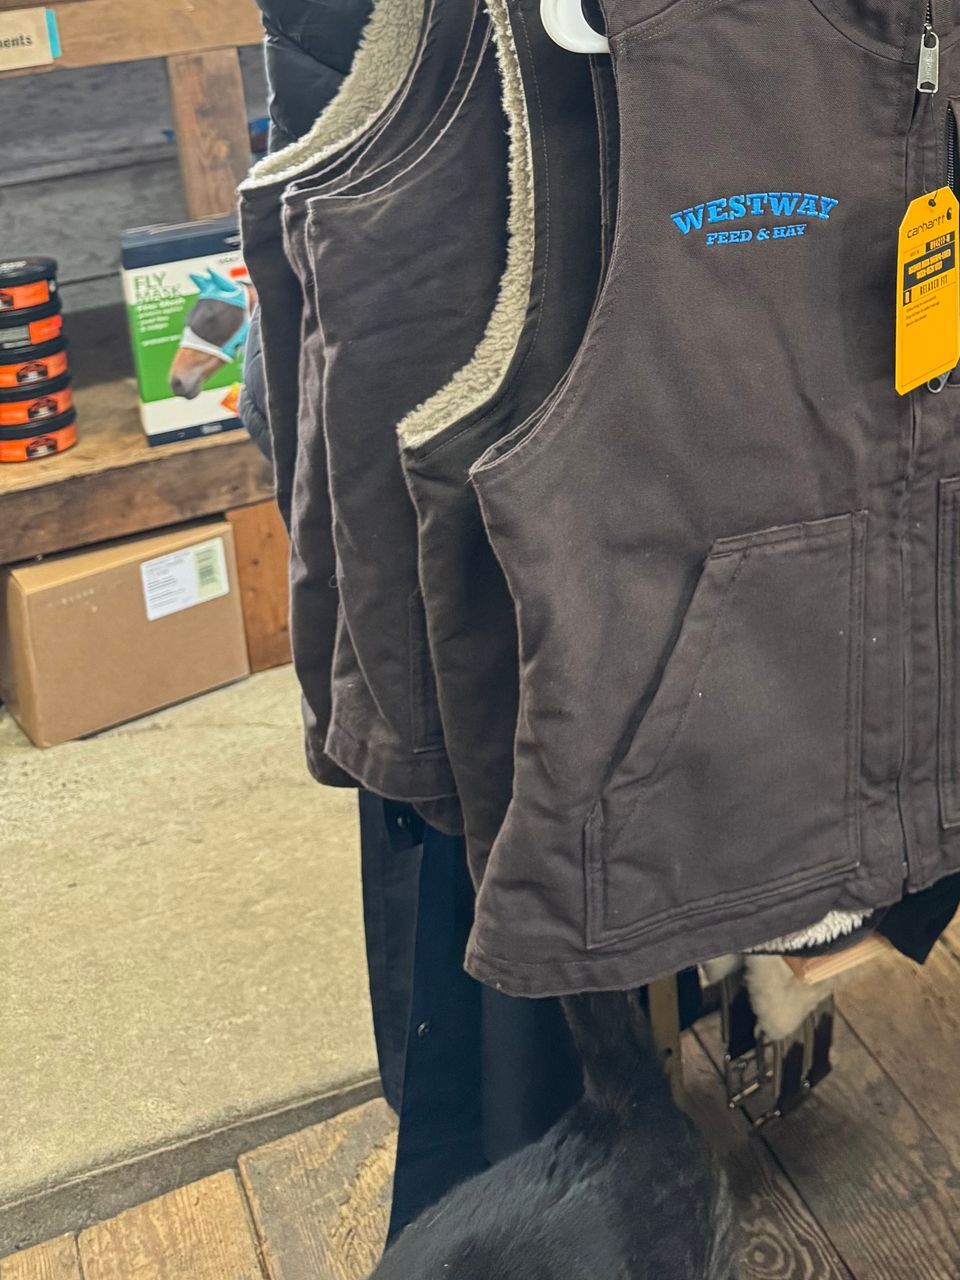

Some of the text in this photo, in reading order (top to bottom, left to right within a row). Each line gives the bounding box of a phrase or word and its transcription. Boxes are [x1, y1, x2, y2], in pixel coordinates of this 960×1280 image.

[670, 192, 839, 235] WESTWAY
[706, 223, 807, 246] FEED & HAY
[906, 213, 945, 239] carhartt
[133, 271, 166, 290] FLY
